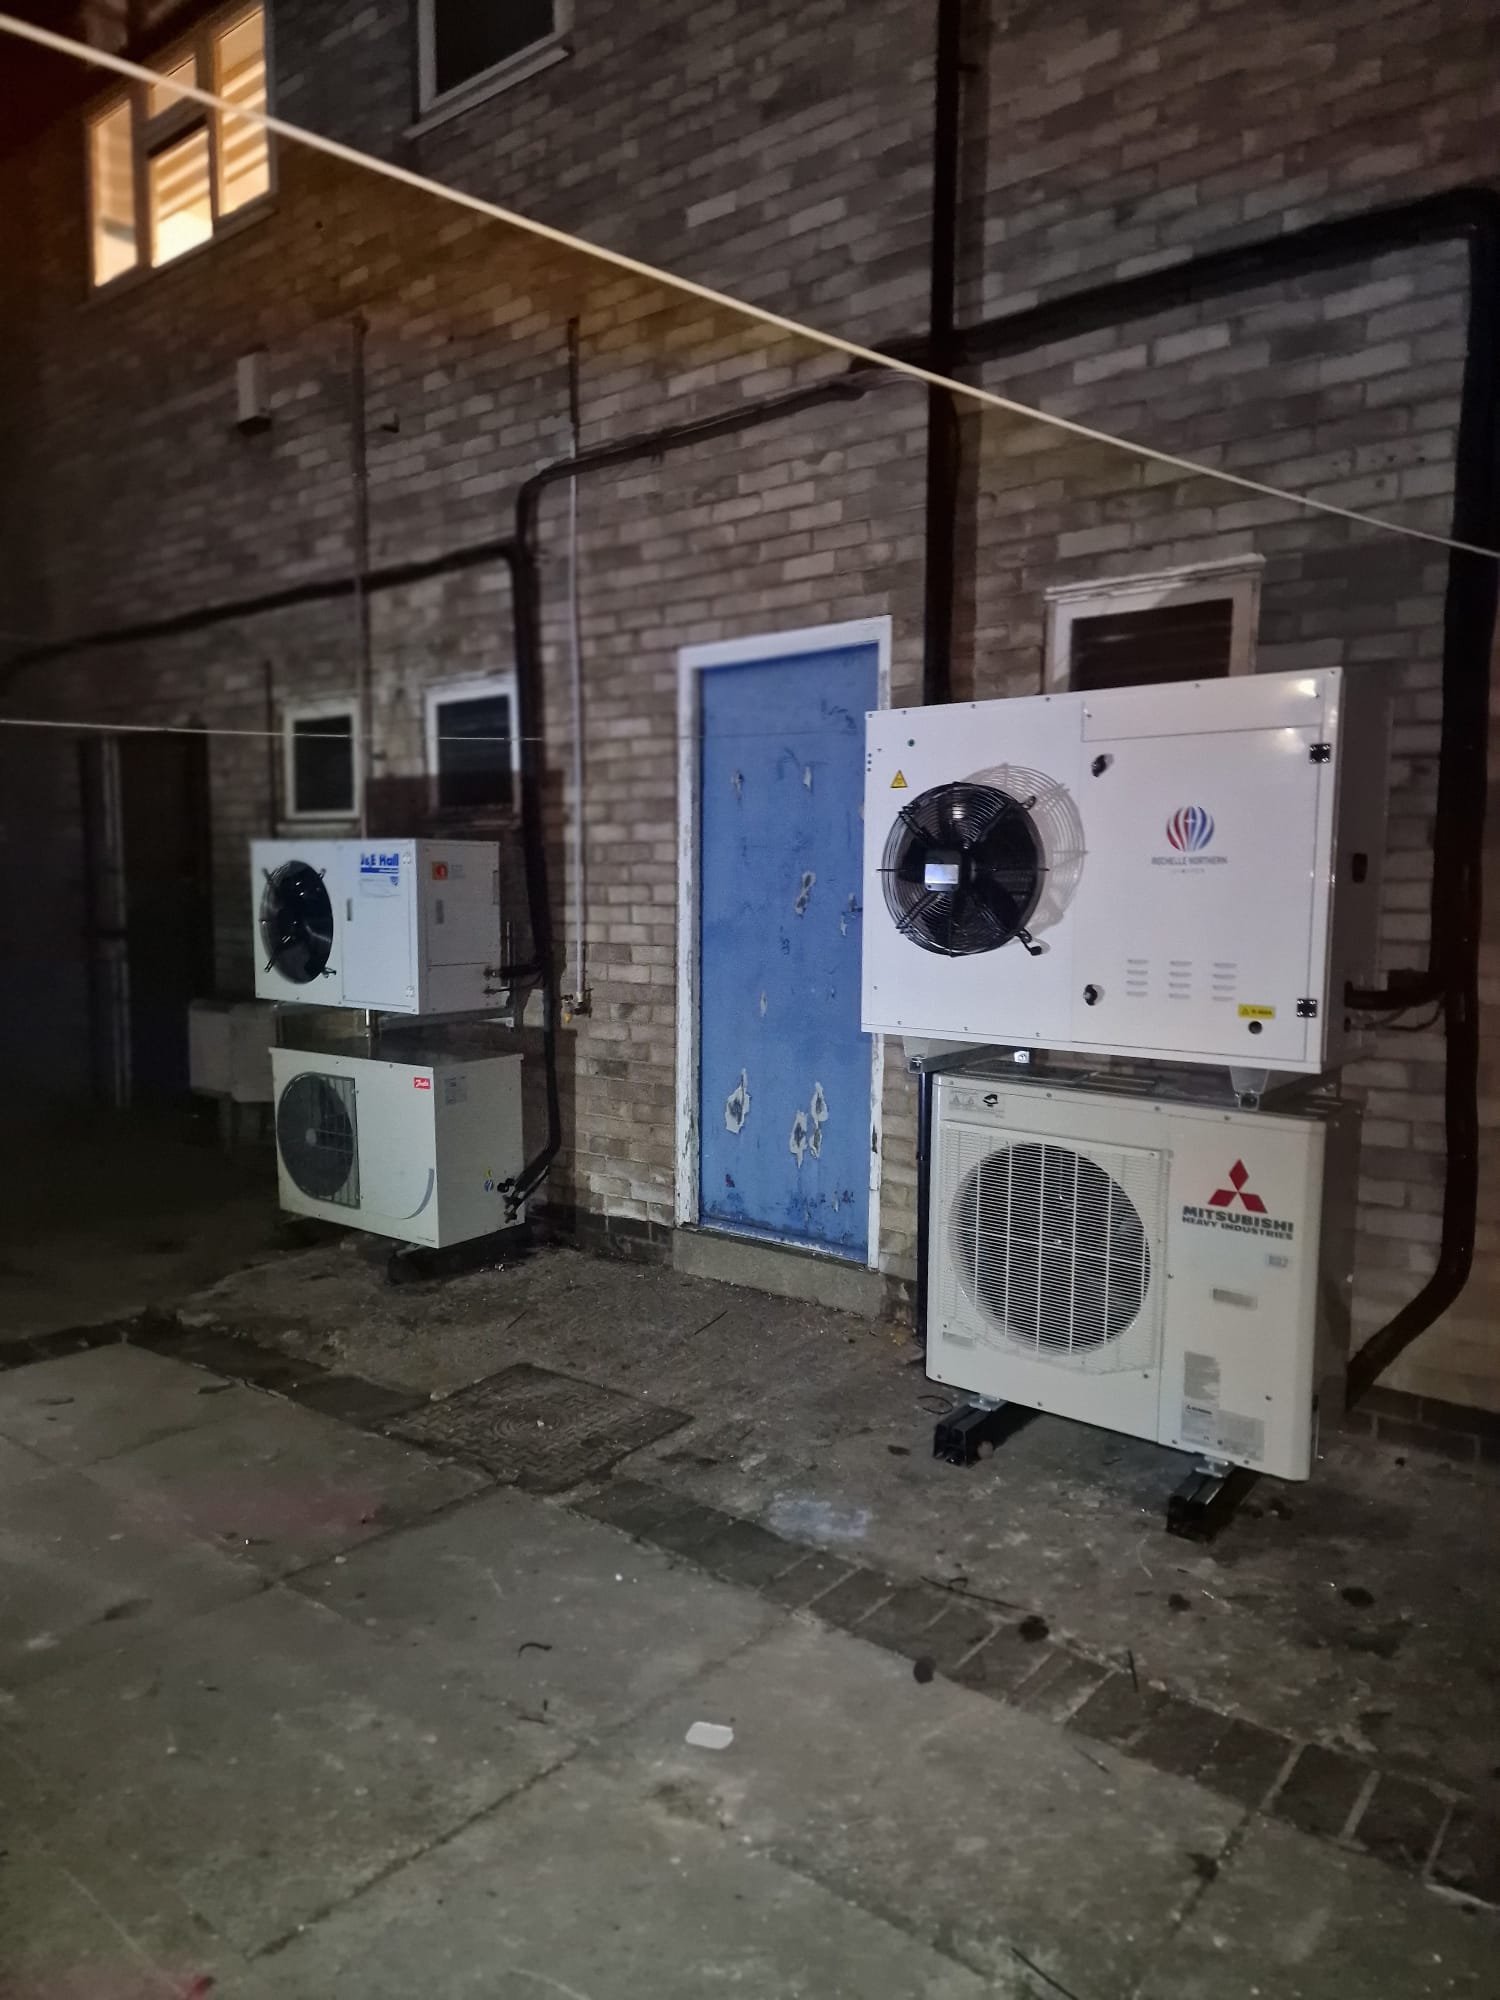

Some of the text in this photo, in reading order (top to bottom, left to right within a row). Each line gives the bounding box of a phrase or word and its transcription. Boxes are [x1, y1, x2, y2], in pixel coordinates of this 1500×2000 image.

[379, 853, 399, 866] Hall
[1182, 1216, 1293, 1240] HEAVY INDUSTRIES
[1183, 1206, 1294, 1233] MITSUBISHI
